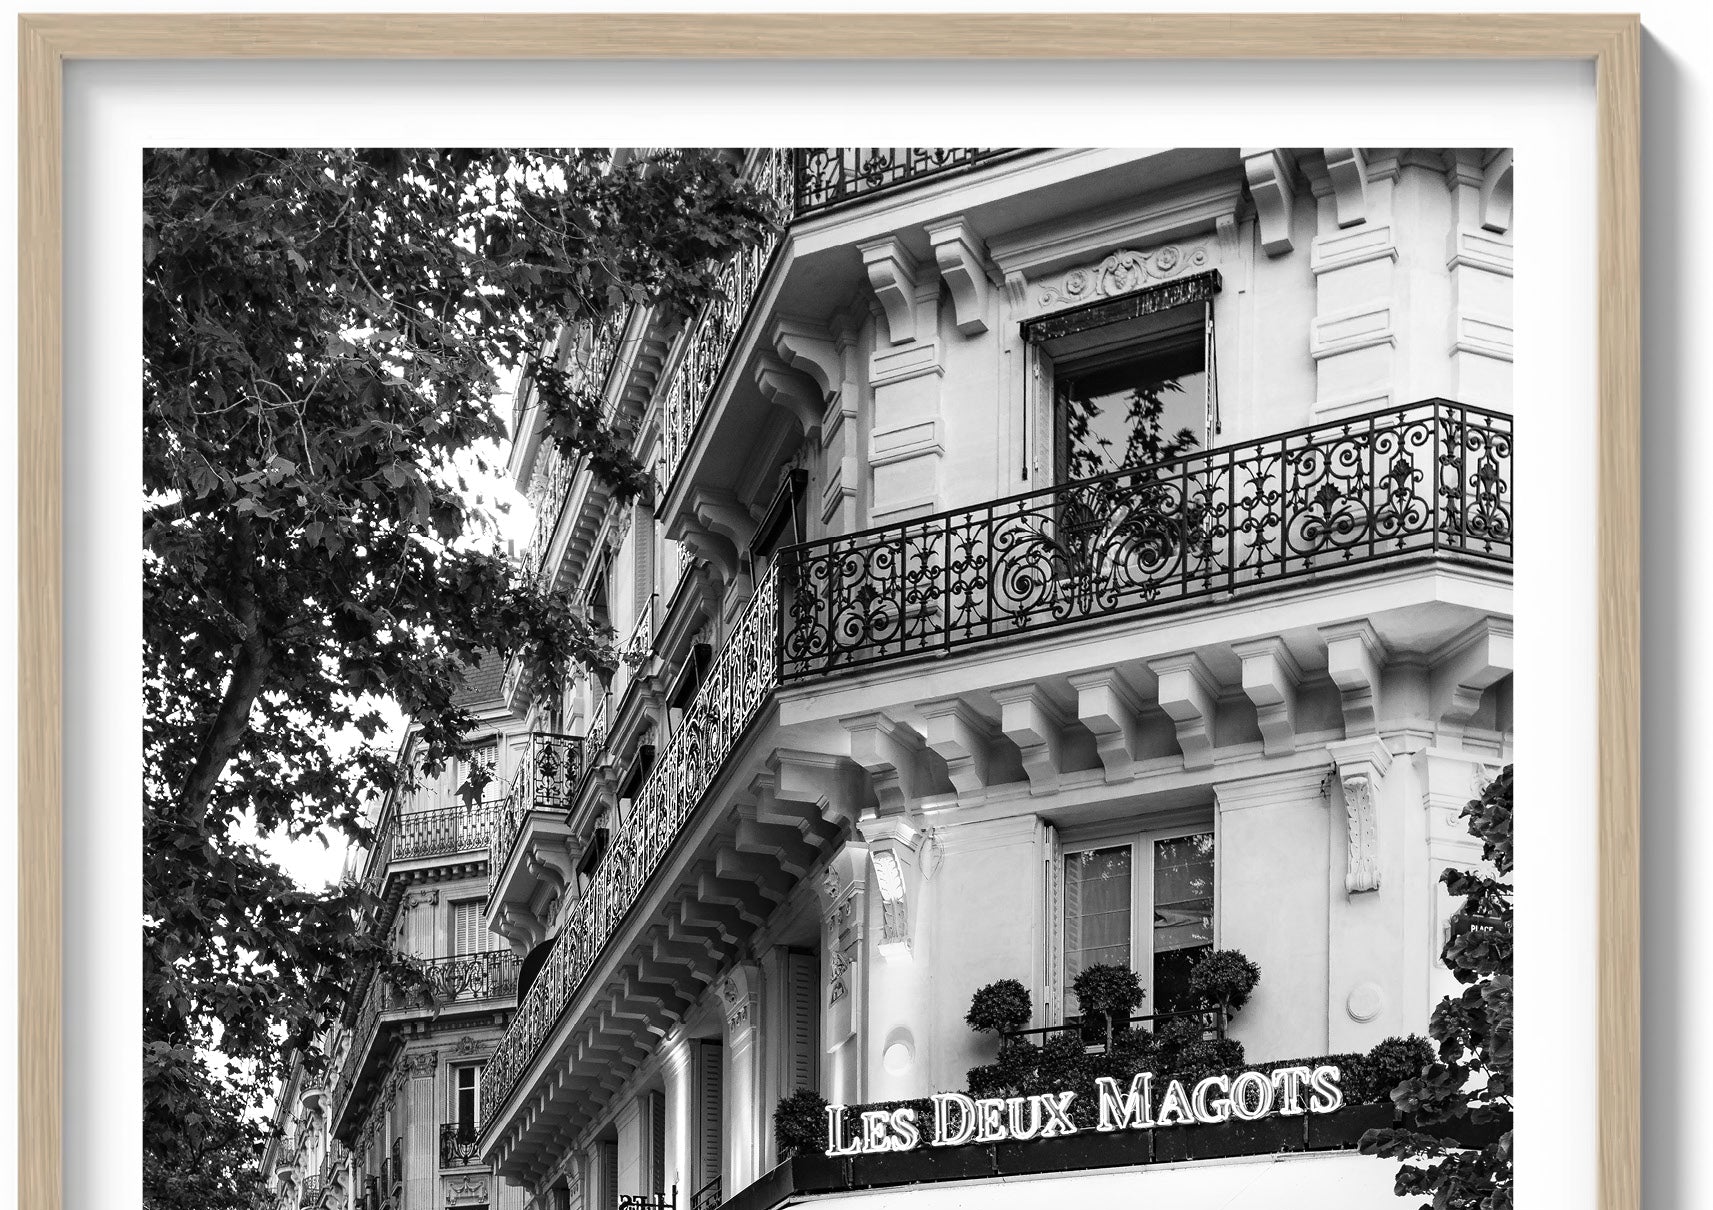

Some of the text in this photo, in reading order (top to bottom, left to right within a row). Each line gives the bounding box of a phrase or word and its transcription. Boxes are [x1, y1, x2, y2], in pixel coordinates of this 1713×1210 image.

[825, 1065, 1344, 1156] LES DEUX MAGOTS
